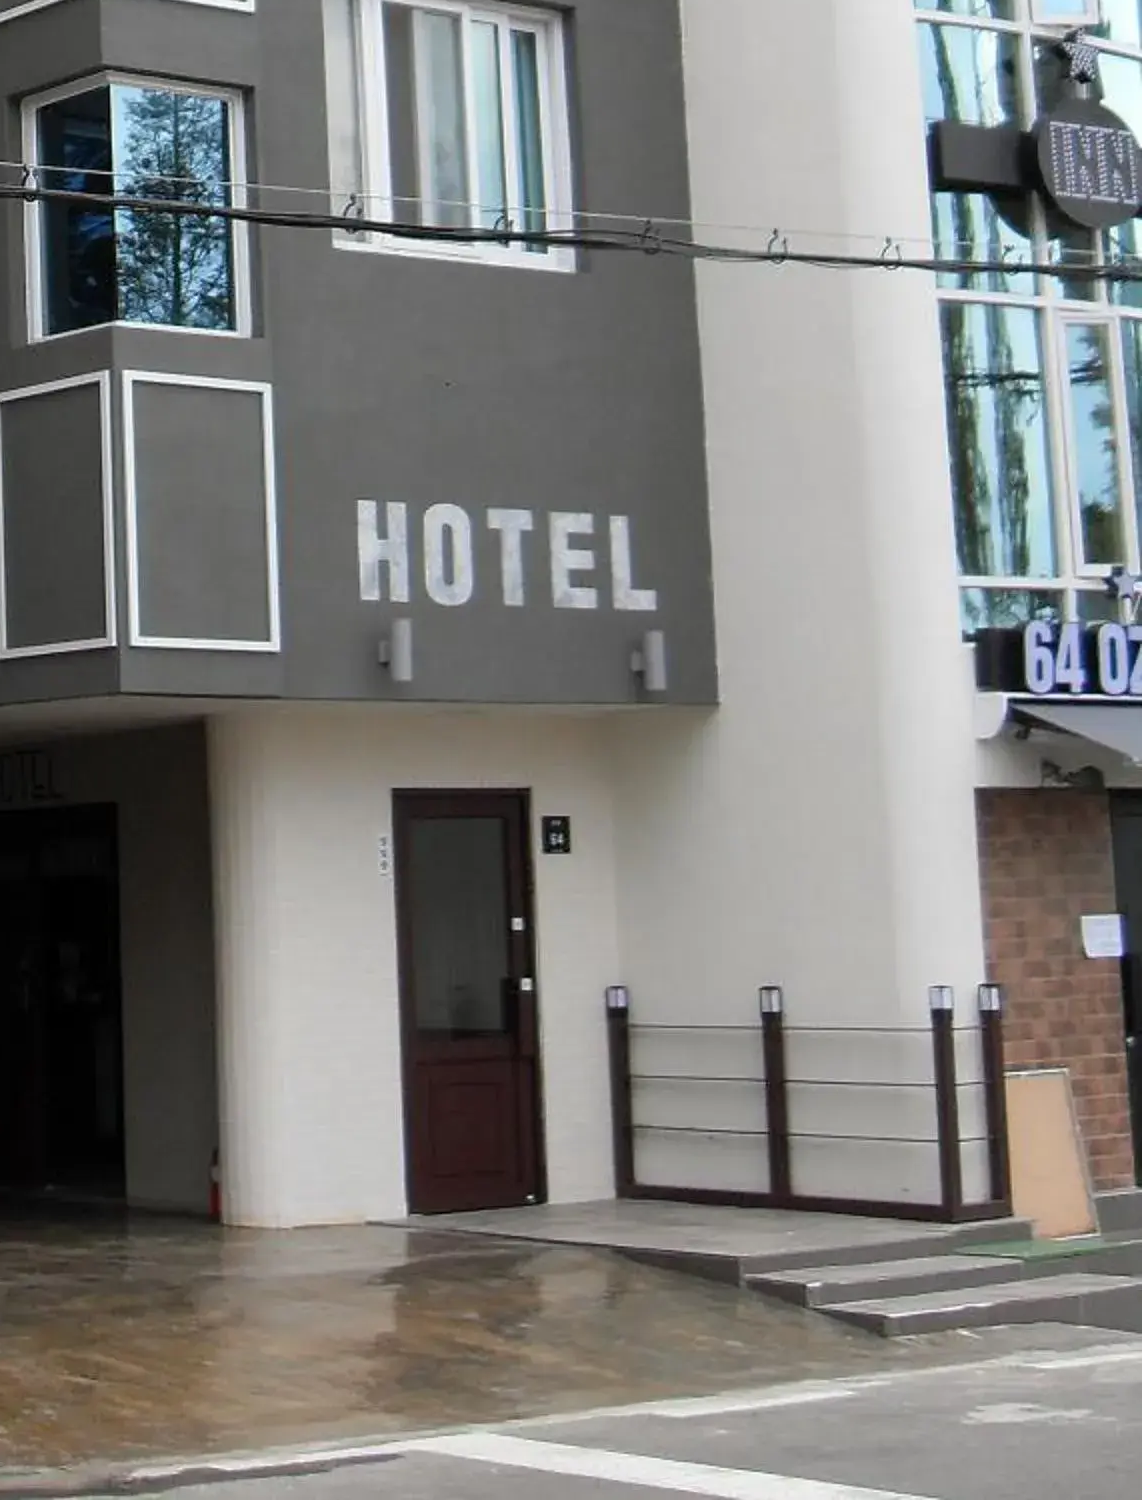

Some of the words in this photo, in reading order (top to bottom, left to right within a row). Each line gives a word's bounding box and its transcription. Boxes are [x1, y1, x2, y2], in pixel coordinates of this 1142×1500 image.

[1050, 121, 1139, 204] INN
[358, 499, 657, 611] HOTEL
[1024, 620, 1087, 694] 64
